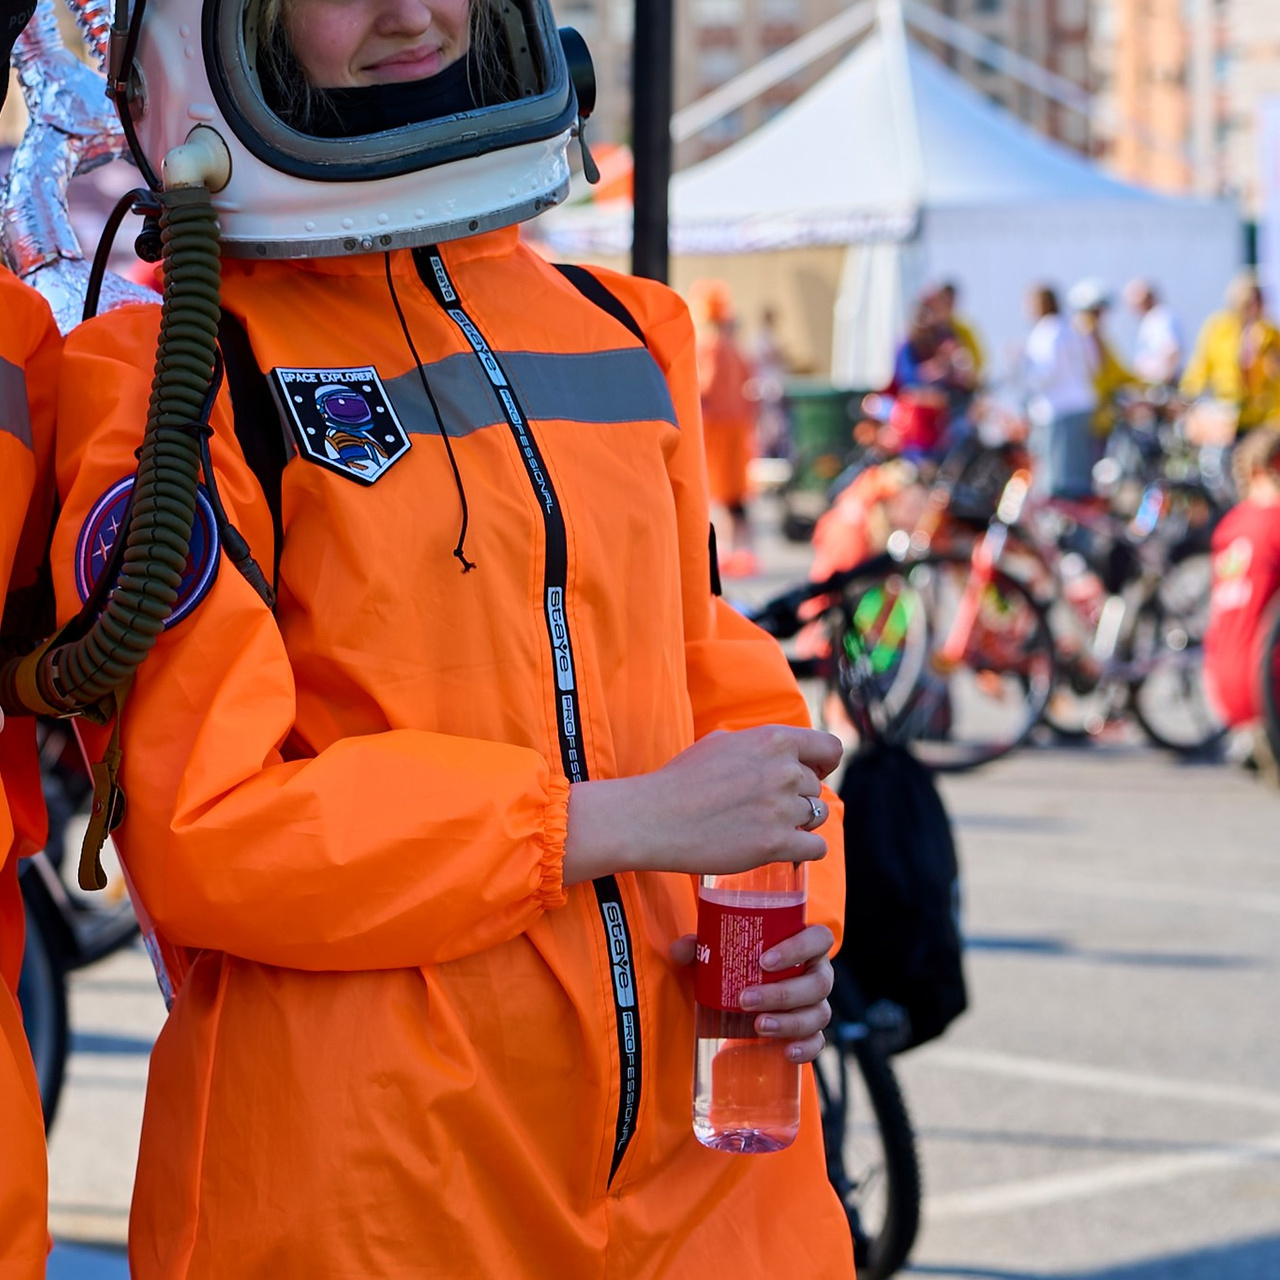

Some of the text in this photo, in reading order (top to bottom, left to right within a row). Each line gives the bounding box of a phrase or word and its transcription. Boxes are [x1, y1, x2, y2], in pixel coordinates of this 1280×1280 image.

[282, 371, 375, 383] SPACE EXPLORER
[501, 391, 553, 515] PROFESSIONAL
[564, 697, 582, 783] PROFESS
[617, 1012, 635, 1151] PROFESSIONAL
